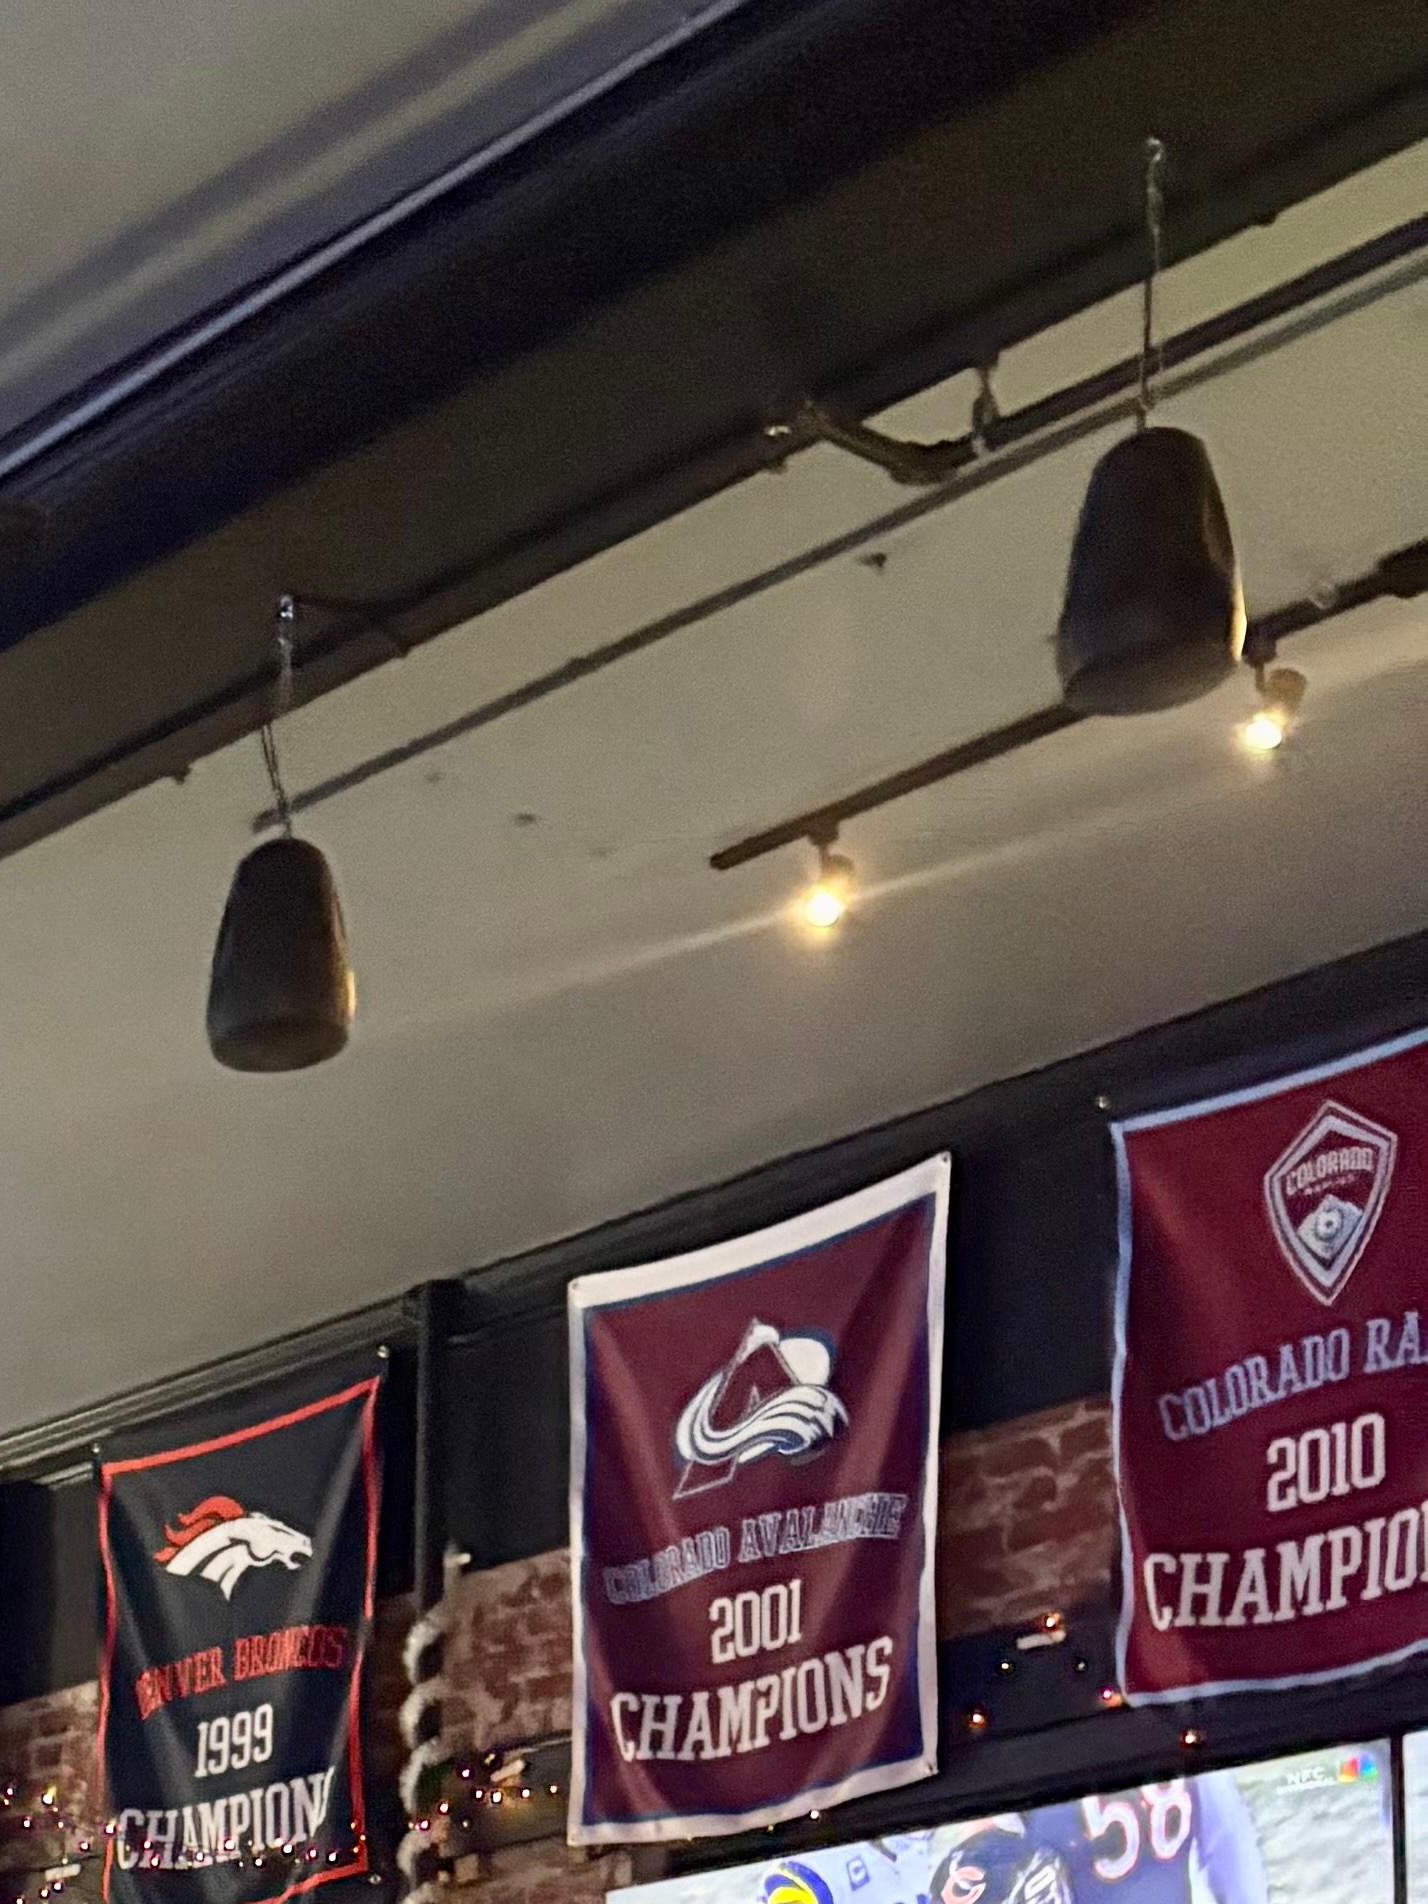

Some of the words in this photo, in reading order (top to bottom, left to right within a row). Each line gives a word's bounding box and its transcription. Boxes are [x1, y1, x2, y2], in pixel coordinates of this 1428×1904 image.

[1286, 1146, 1374, 1196] COLORADO
[1160, 1327, 1350, 1439] COLORADO
[1364, 1311, 1428, 1374] RA
[1266, 1413, 1387, 1512] 2010
[603, 1521, 729, 1605] COLORADO
[739, 1492, 909, 1558] AVALANCHE
[1144, 1510, 1428, 1632] CHAMPIO
[709, 1579, 803, 1664] 2001
[194, 1703, 273, 1778] 1999
[610, 1636, 893, 1763] CHAMPIONS
[117, 1765, 335, 1870] CHAMPION
[1084, 1776, 1193, 1885] 58
